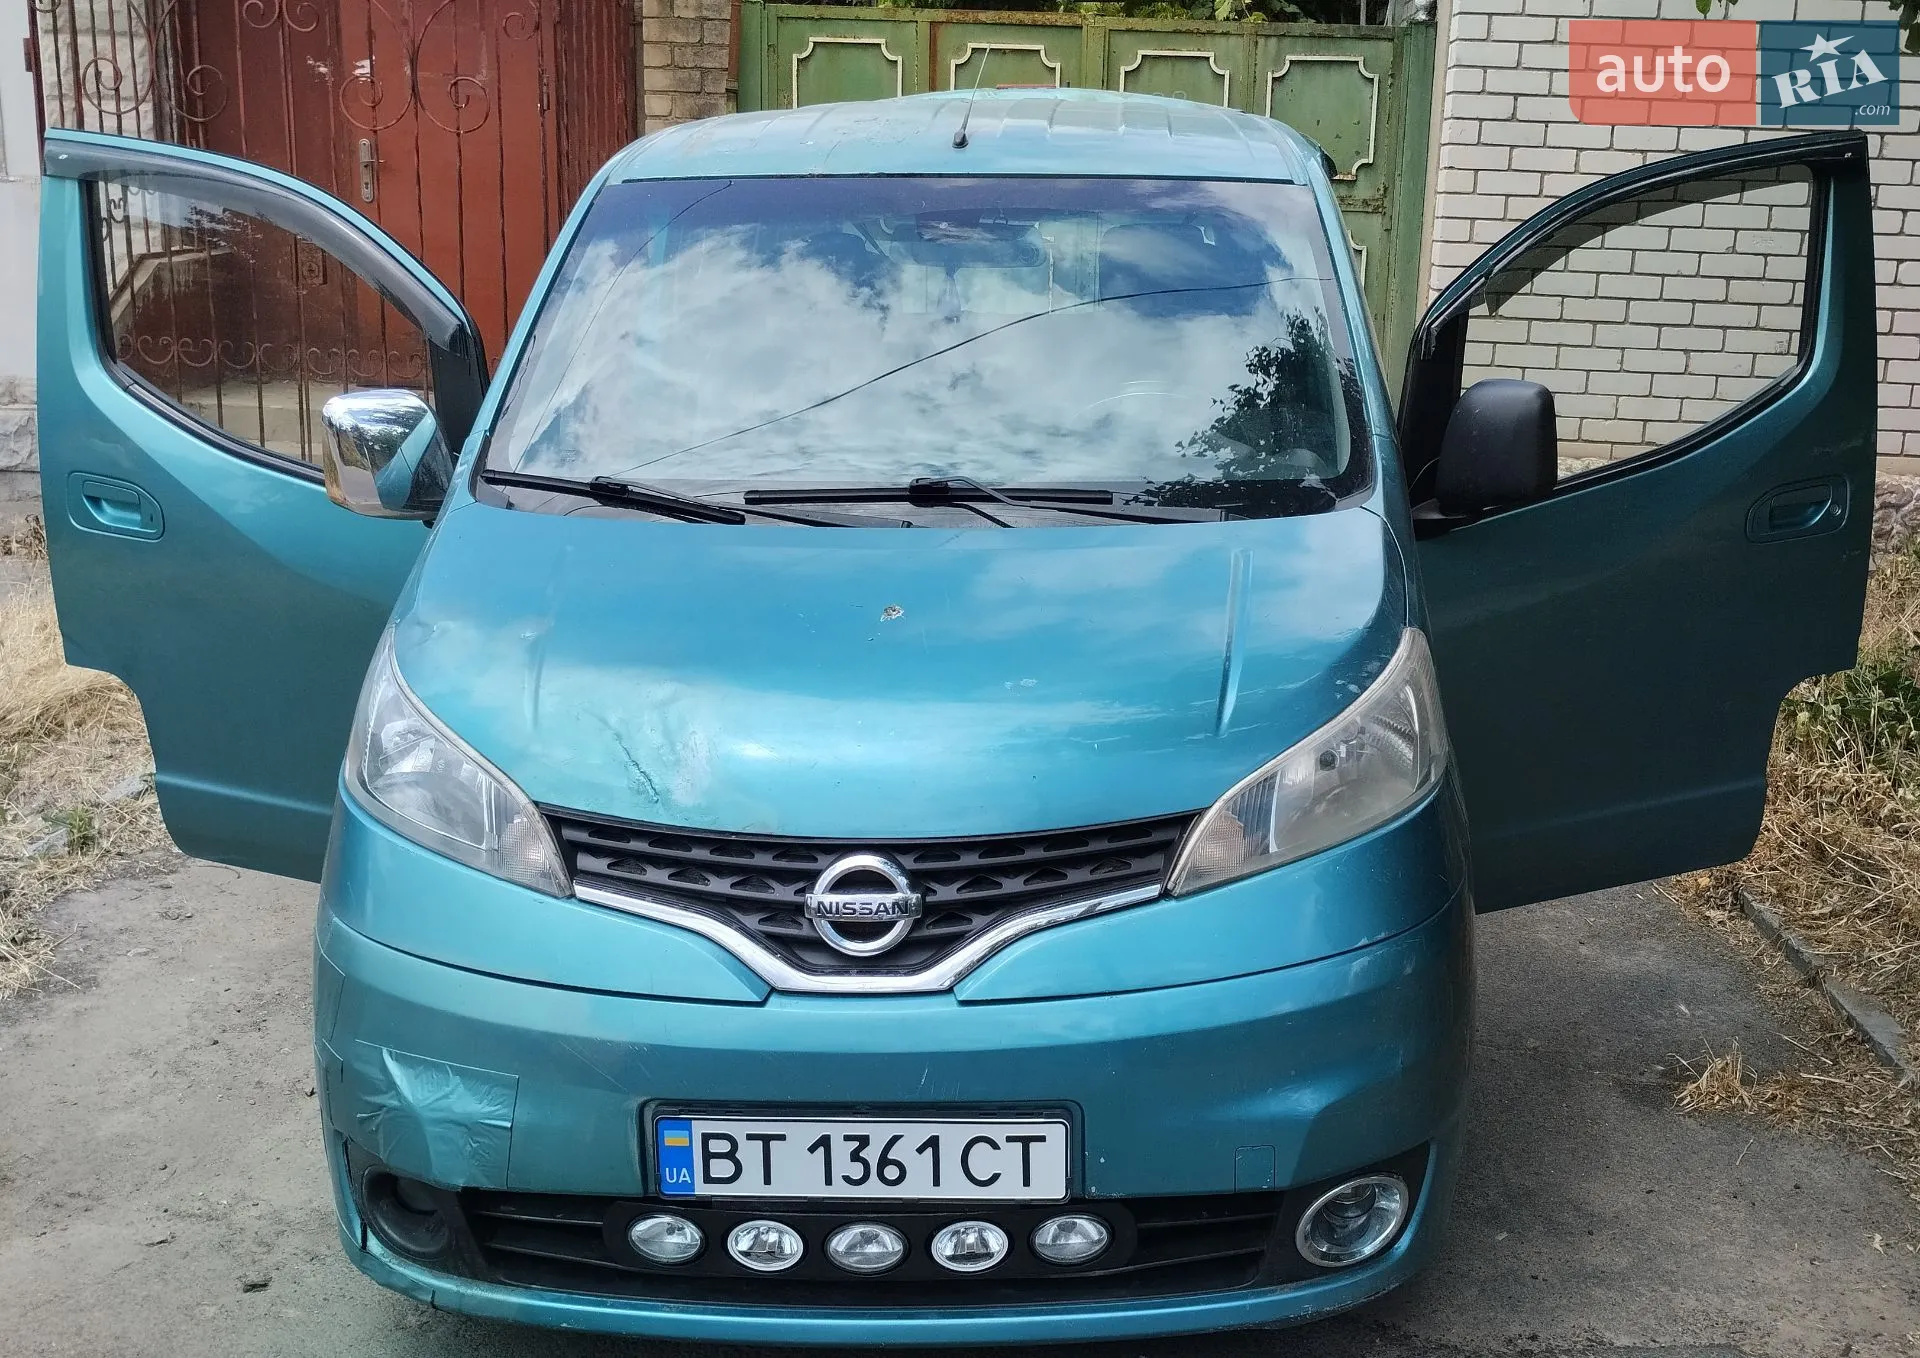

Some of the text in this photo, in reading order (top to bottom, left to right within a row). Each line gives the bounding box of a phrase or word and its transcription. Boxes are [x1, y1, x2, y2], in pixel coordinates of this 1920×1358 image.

[816, 901, 910, 916] NISSAN
[701, 1132, 1047, 1188] BT 1361 CT
[665, 1167, 691, 1184] UA
